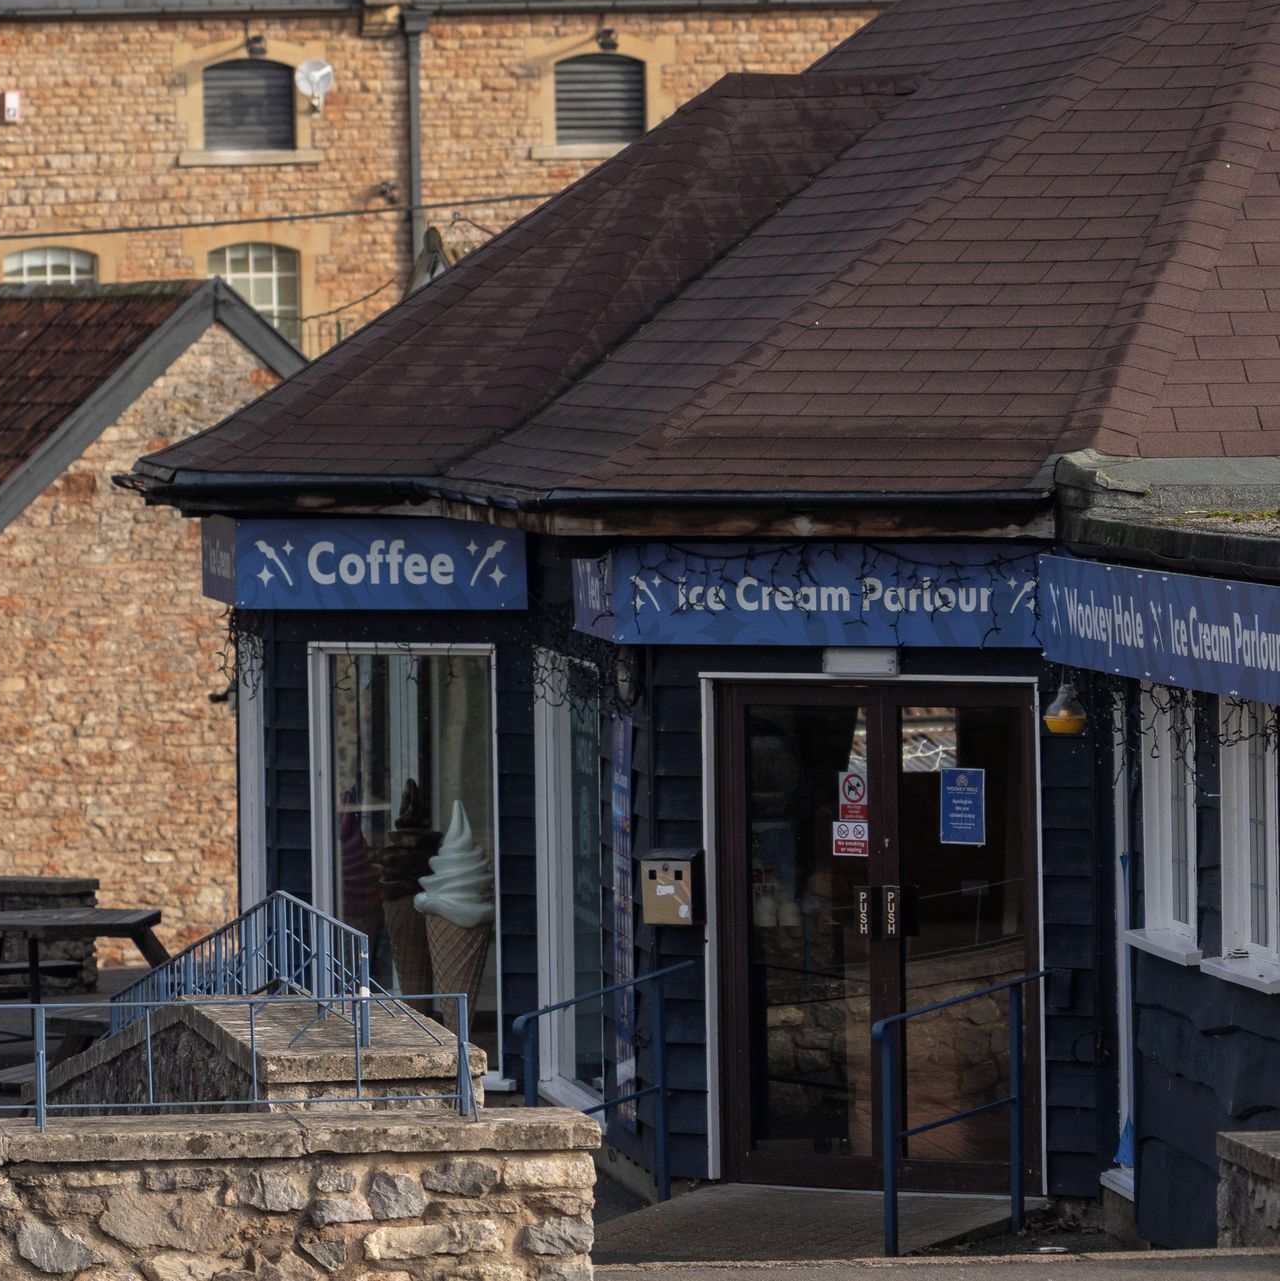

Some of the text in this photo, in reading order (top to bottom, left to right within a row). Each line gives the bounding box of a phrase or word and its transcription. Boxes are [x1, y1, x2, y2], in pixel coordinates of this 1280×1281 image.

[307, 539, 455, 585] Coffee
[678, 576, 993, 613] Ice Cream Parlour
[1064, 586, 1144, 658] Wookey Hole
[1169, 603, 1280, 672] Ice Cream Parlour
[859, 891, 868, 935] PUSH
[887, 891, 896, 935] PUSH
